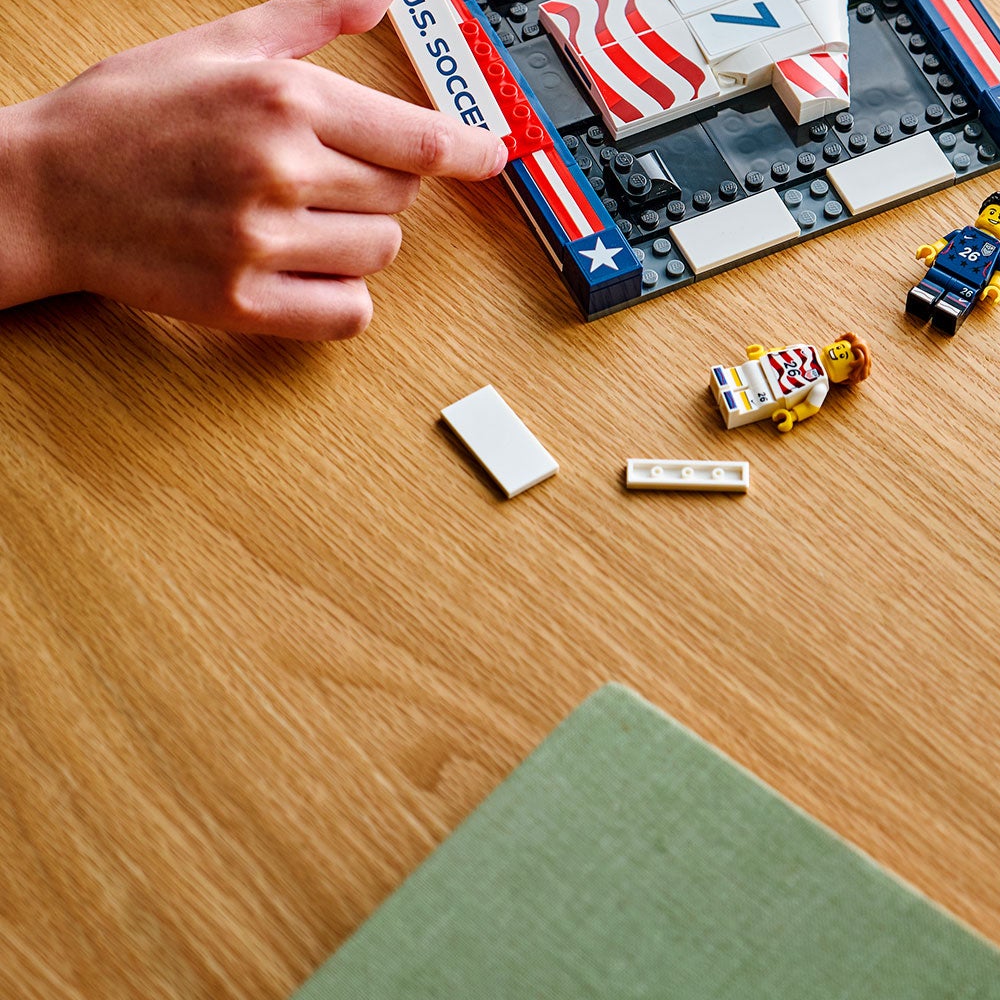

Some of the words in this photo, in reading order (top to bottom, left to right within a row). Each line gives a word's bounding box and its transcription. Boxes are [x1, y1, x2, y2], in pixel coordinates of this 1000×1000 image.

[426, 37, 490, 131] SOCCE
[959, 247, 981, 261] 26
[960, 287, 973, 298] 26
[783, 361, 801, 377] 26
[757, 392, 768, 403] 26
